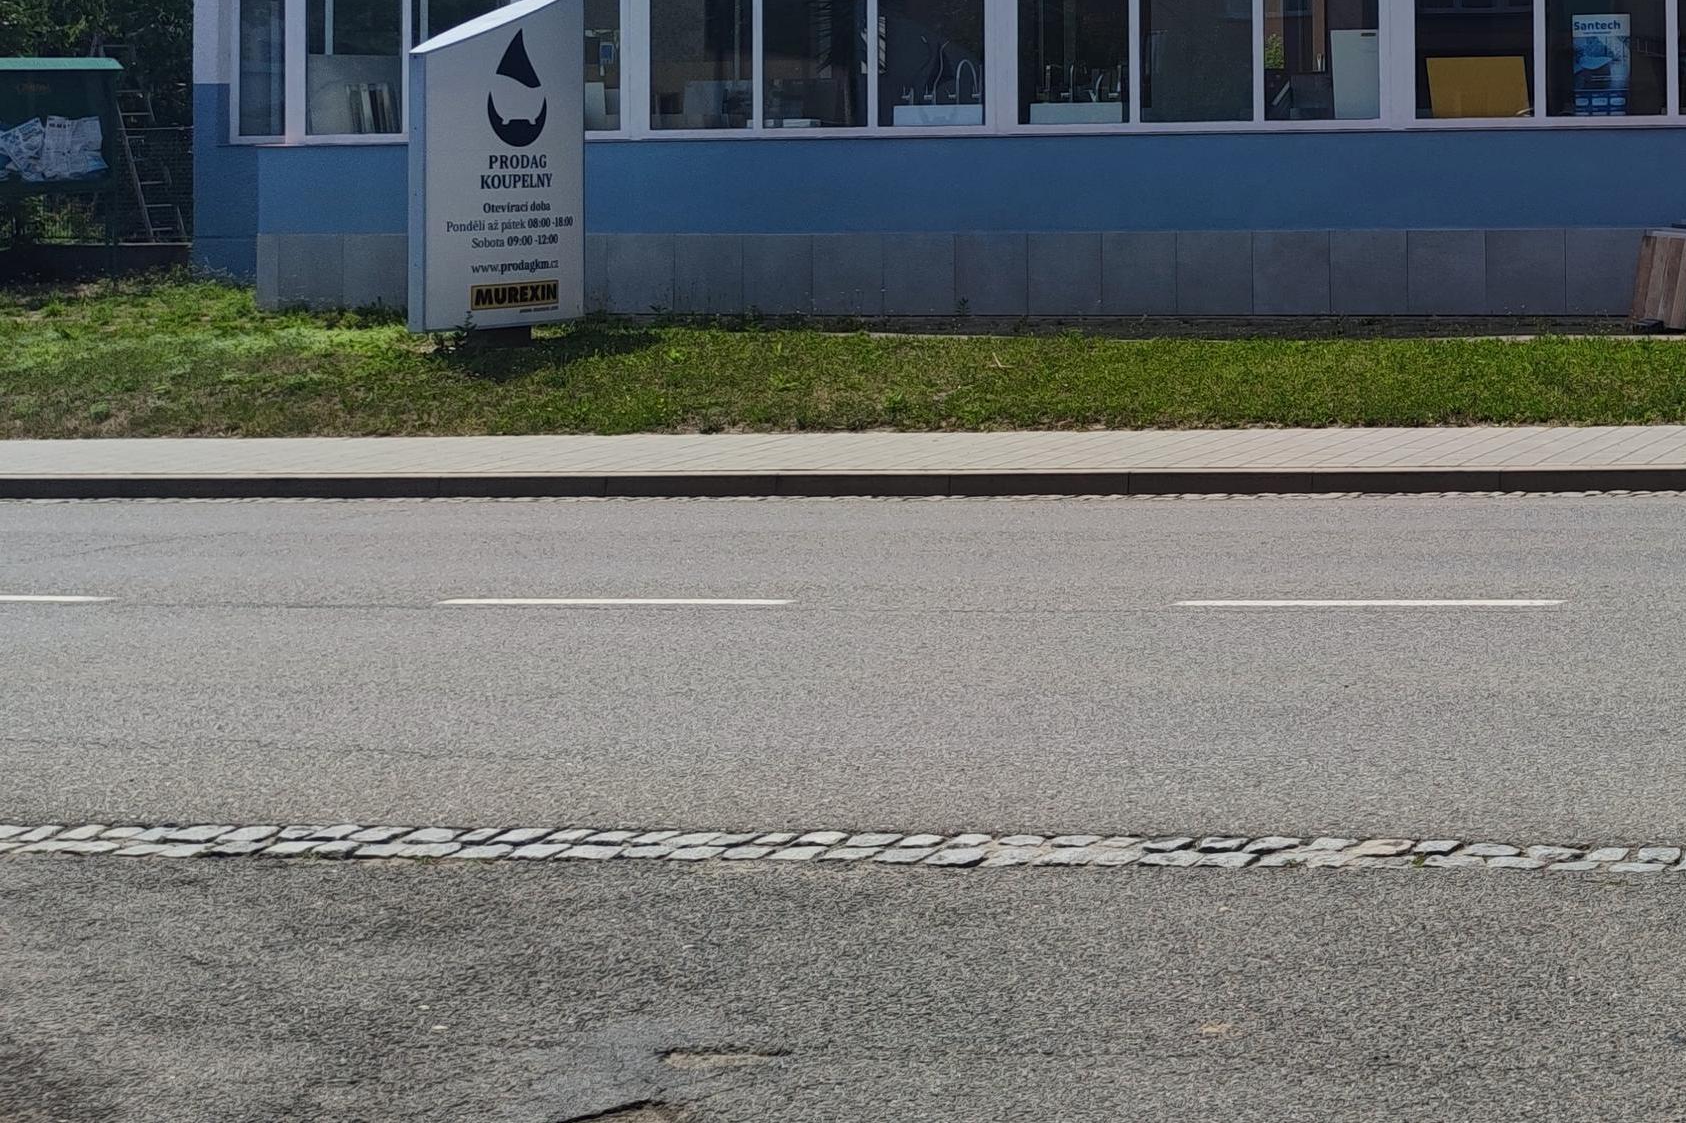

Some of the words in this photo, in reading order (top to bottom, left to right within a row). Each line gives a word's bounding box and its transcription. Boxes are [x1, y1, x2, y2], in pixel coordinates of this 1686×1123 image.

[1574, 20, 1621, 31] Santech
[488, 154, 547, 170] PRODAG
[480, 173, 553, 190] KOUPELNY
[483, 201, 529, 213] Otevírací
[530, 200, 551, 212] doba
[446, 219, 486, 233] Pondělí
[488, 219, 499, 231] až
[501, 218, 526, 233] pátek
[527, 216, 551, 229] 08:00
[471, 237, 505, 249] Sobota
[507, 234, 533, 247] 09:00
[471, 258, 559, 275] www.prodagkm.cz
[474, 282, 557, 306] MUREXIN
